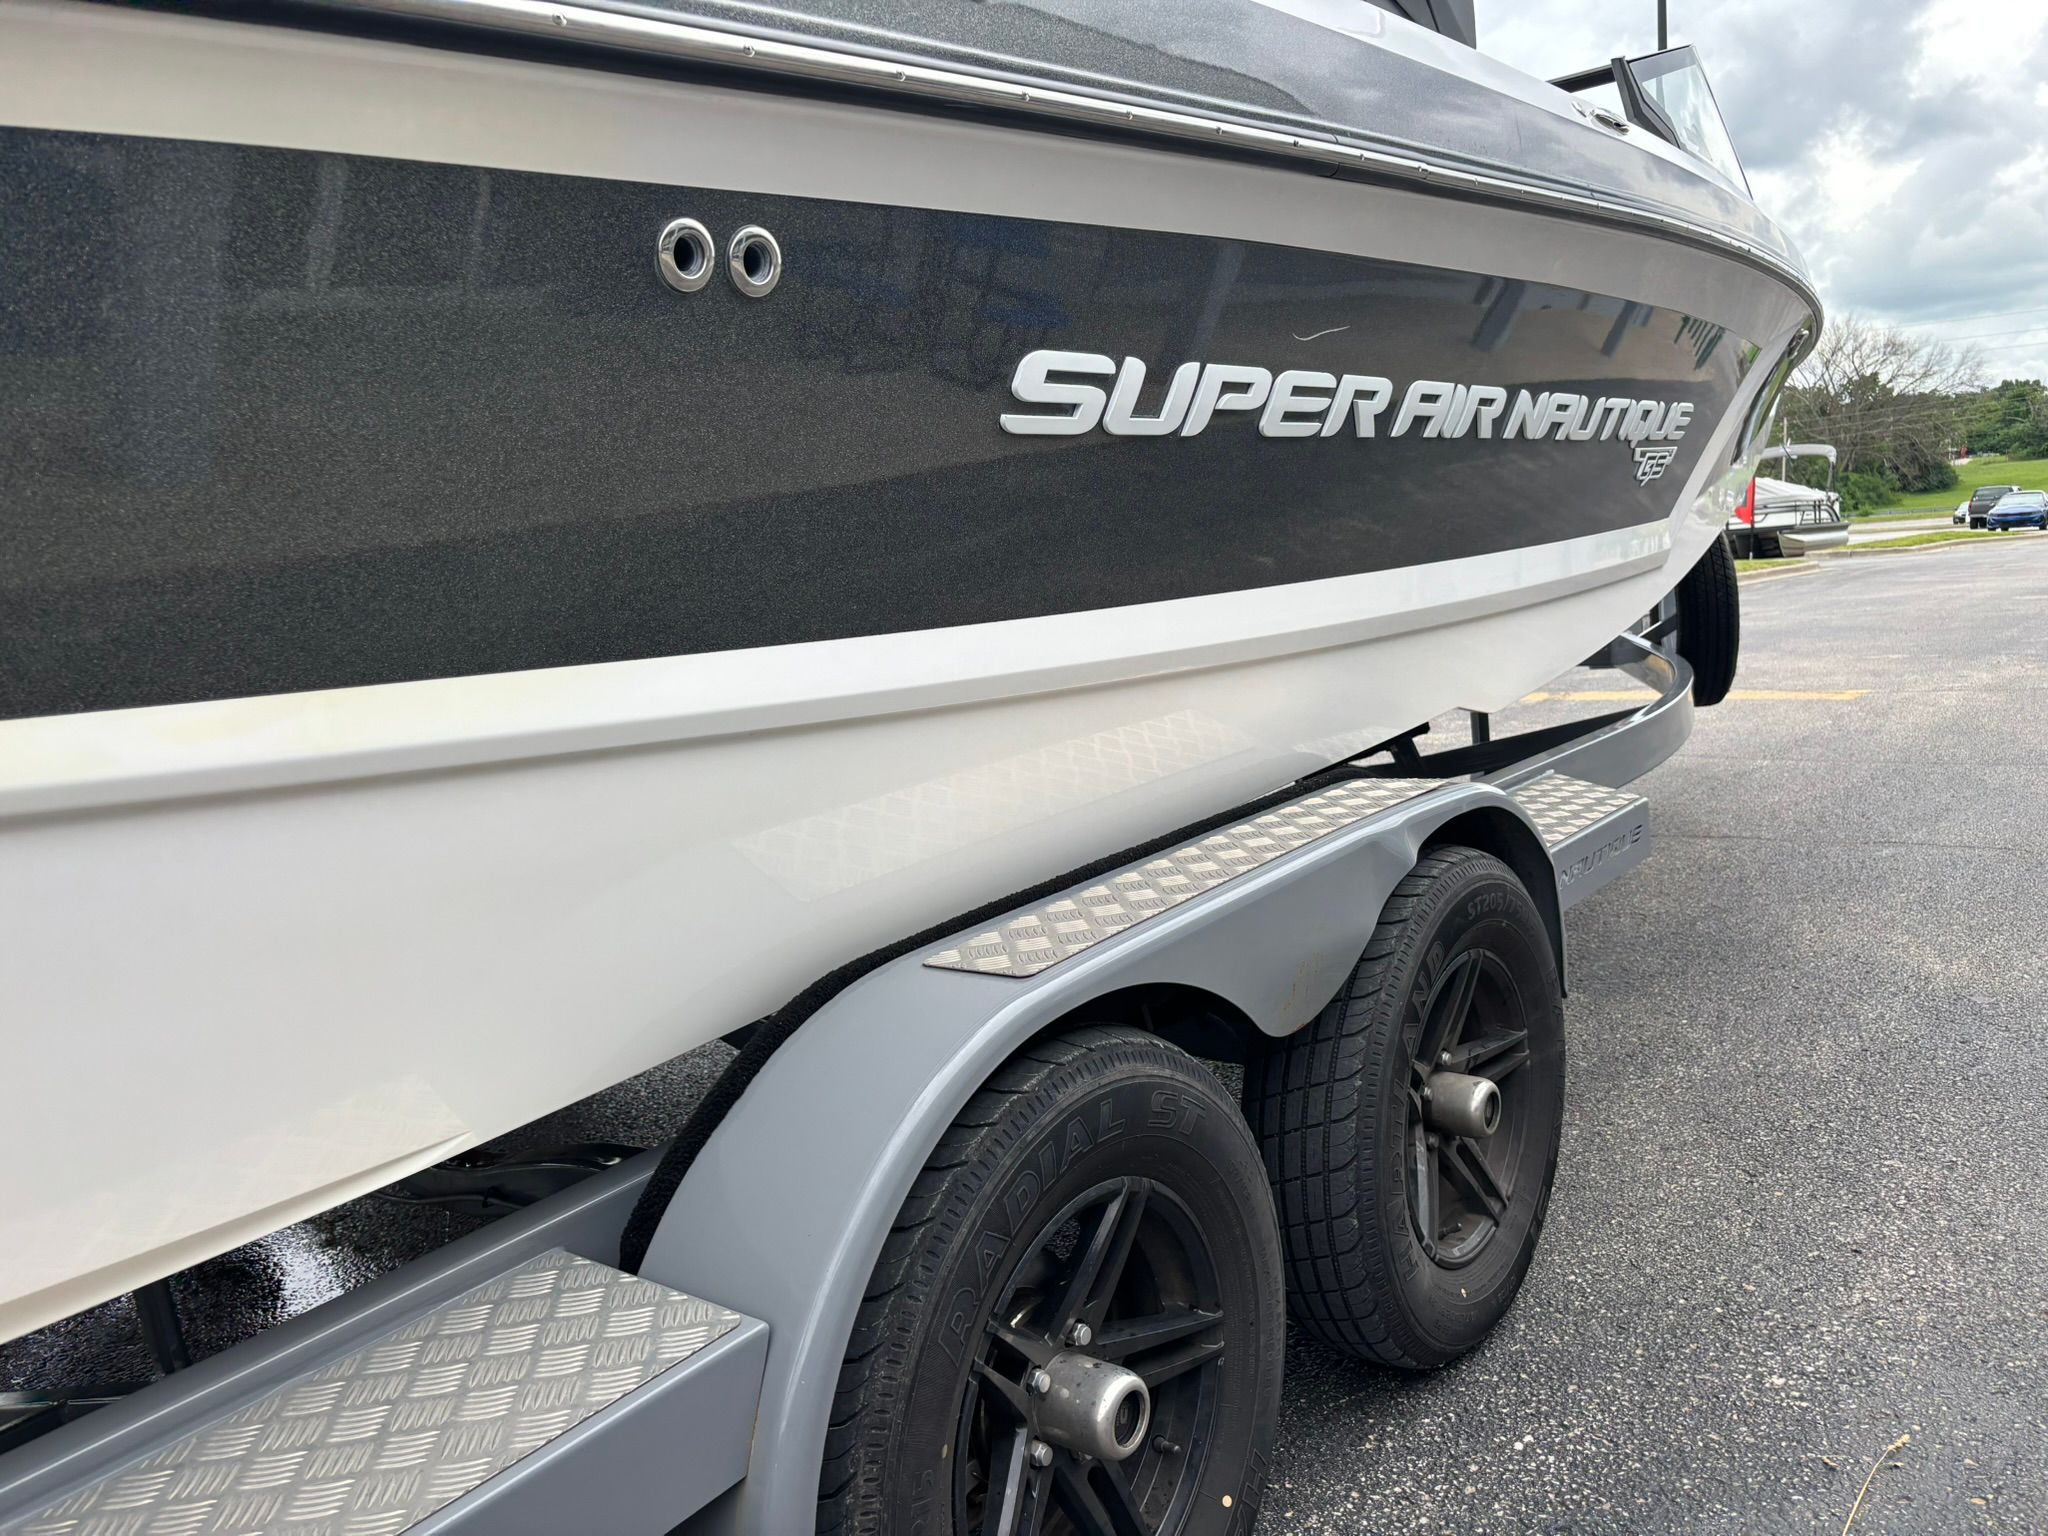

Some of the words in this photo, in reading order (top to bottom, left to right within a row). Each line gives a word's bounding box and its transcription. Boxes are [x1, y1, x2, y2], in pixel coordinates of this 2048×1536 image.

[1000, 349, 1393, 438] SUPER
[1389, 379, 1507, 439] AIR
[1503, 388, 1695, 447] NAUTIQUE
[1559, 824, 1643, 890] NAUTIQUE
[938, 1098, 1127, 1369] RADIAL
[1146, 1088, 1208, 1137] ST
